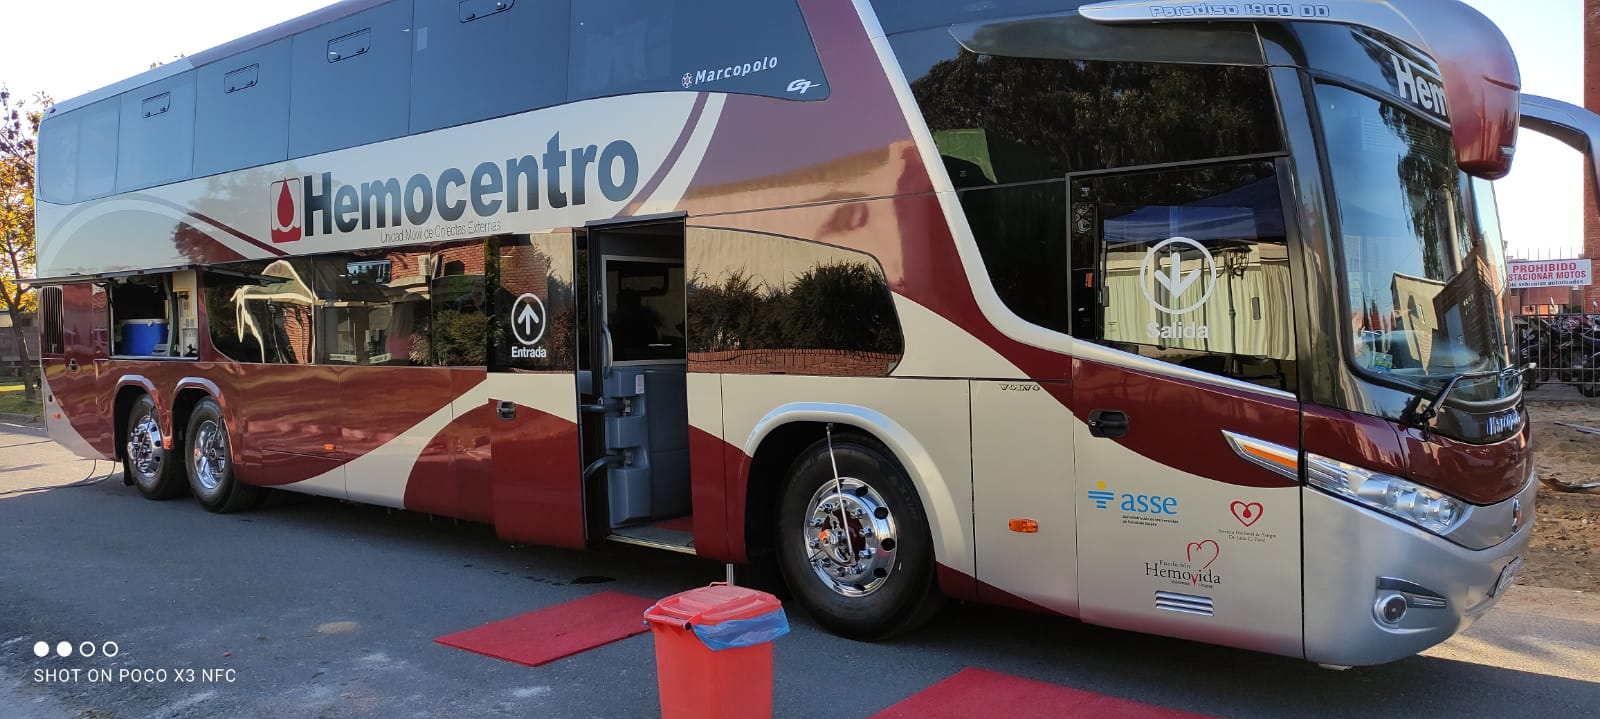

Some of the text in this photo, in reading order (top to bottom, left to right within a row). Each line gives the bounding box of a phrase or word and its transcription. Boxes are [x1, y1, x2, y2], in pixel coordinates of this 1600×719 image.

[1149, 3, 1240, 17] Paradiso
[1244, 3, 1293, 16] 1800
[694, 56, 778, 85] Marcopolo
[303, 130, 640, 237] Hemocentro
[380, 229, 404, 243] Unidad
[424, 228, 433, 239] de
[468, 220, 502, 235] Externas
[1512, 262, 1577, 273] PROHIBIDO
[1556, 270, 1586, 280] MOTOS
[1147, 321, 1209, 339] Salida
[511, 346, 547, 358] Entrada
[999, 383, 1041, 392] VOLVO
[1121, 493, 1178, 515] asse
